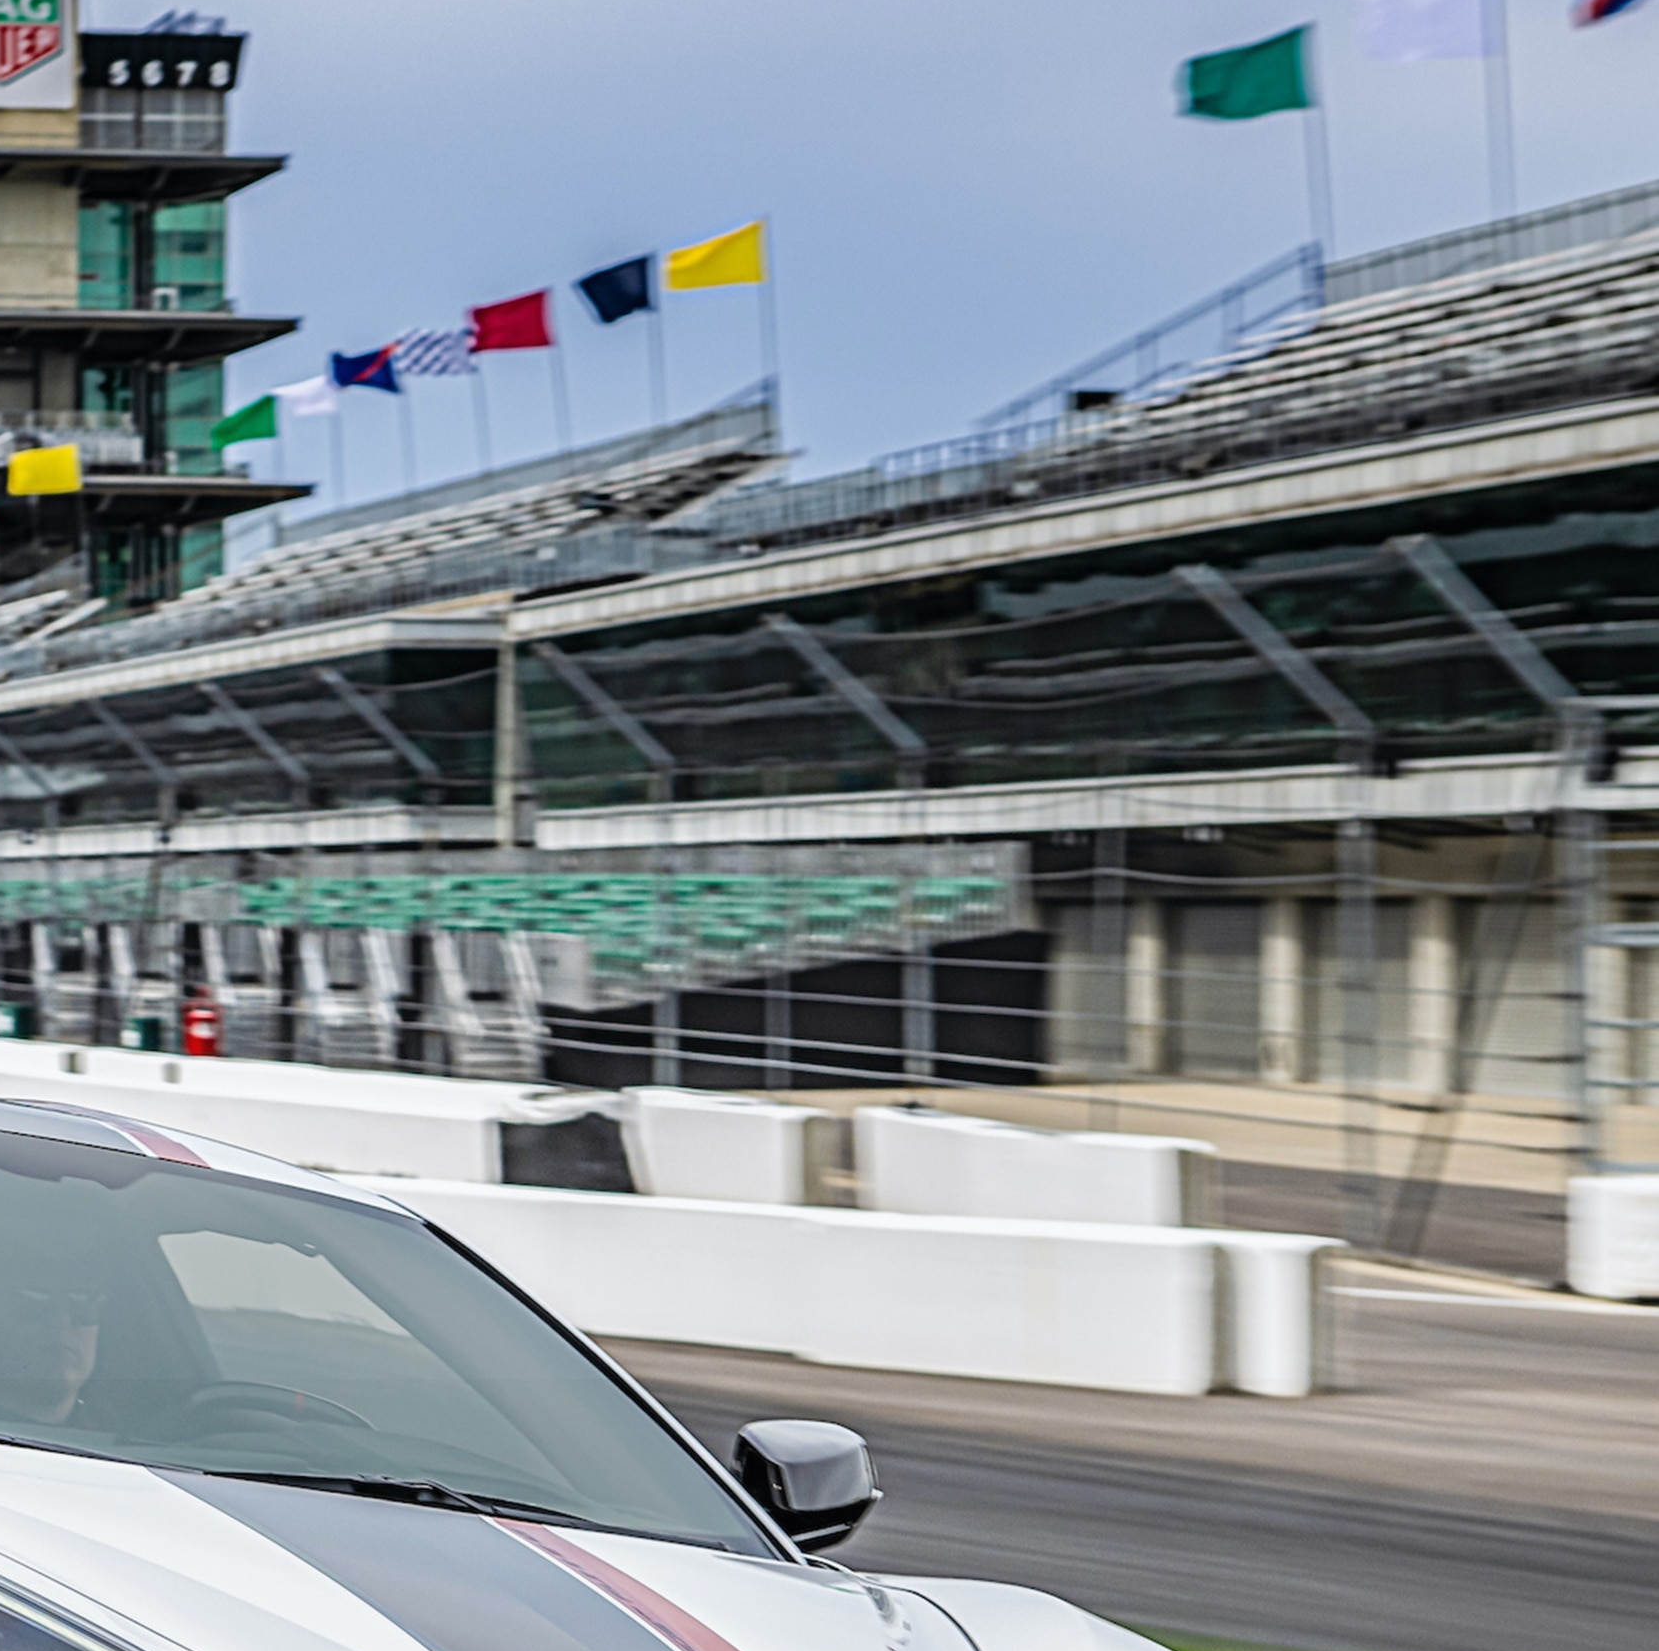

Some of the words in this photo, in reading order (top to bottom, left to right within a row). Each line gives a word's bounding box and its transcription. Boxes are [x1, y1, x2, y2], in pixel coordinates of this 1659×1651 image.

[108, 59, 131, 87] 5
[141, 59, 165, 87] 6
[175, 60, 198, 87] 7
[208, 60, 231, 87] 8
